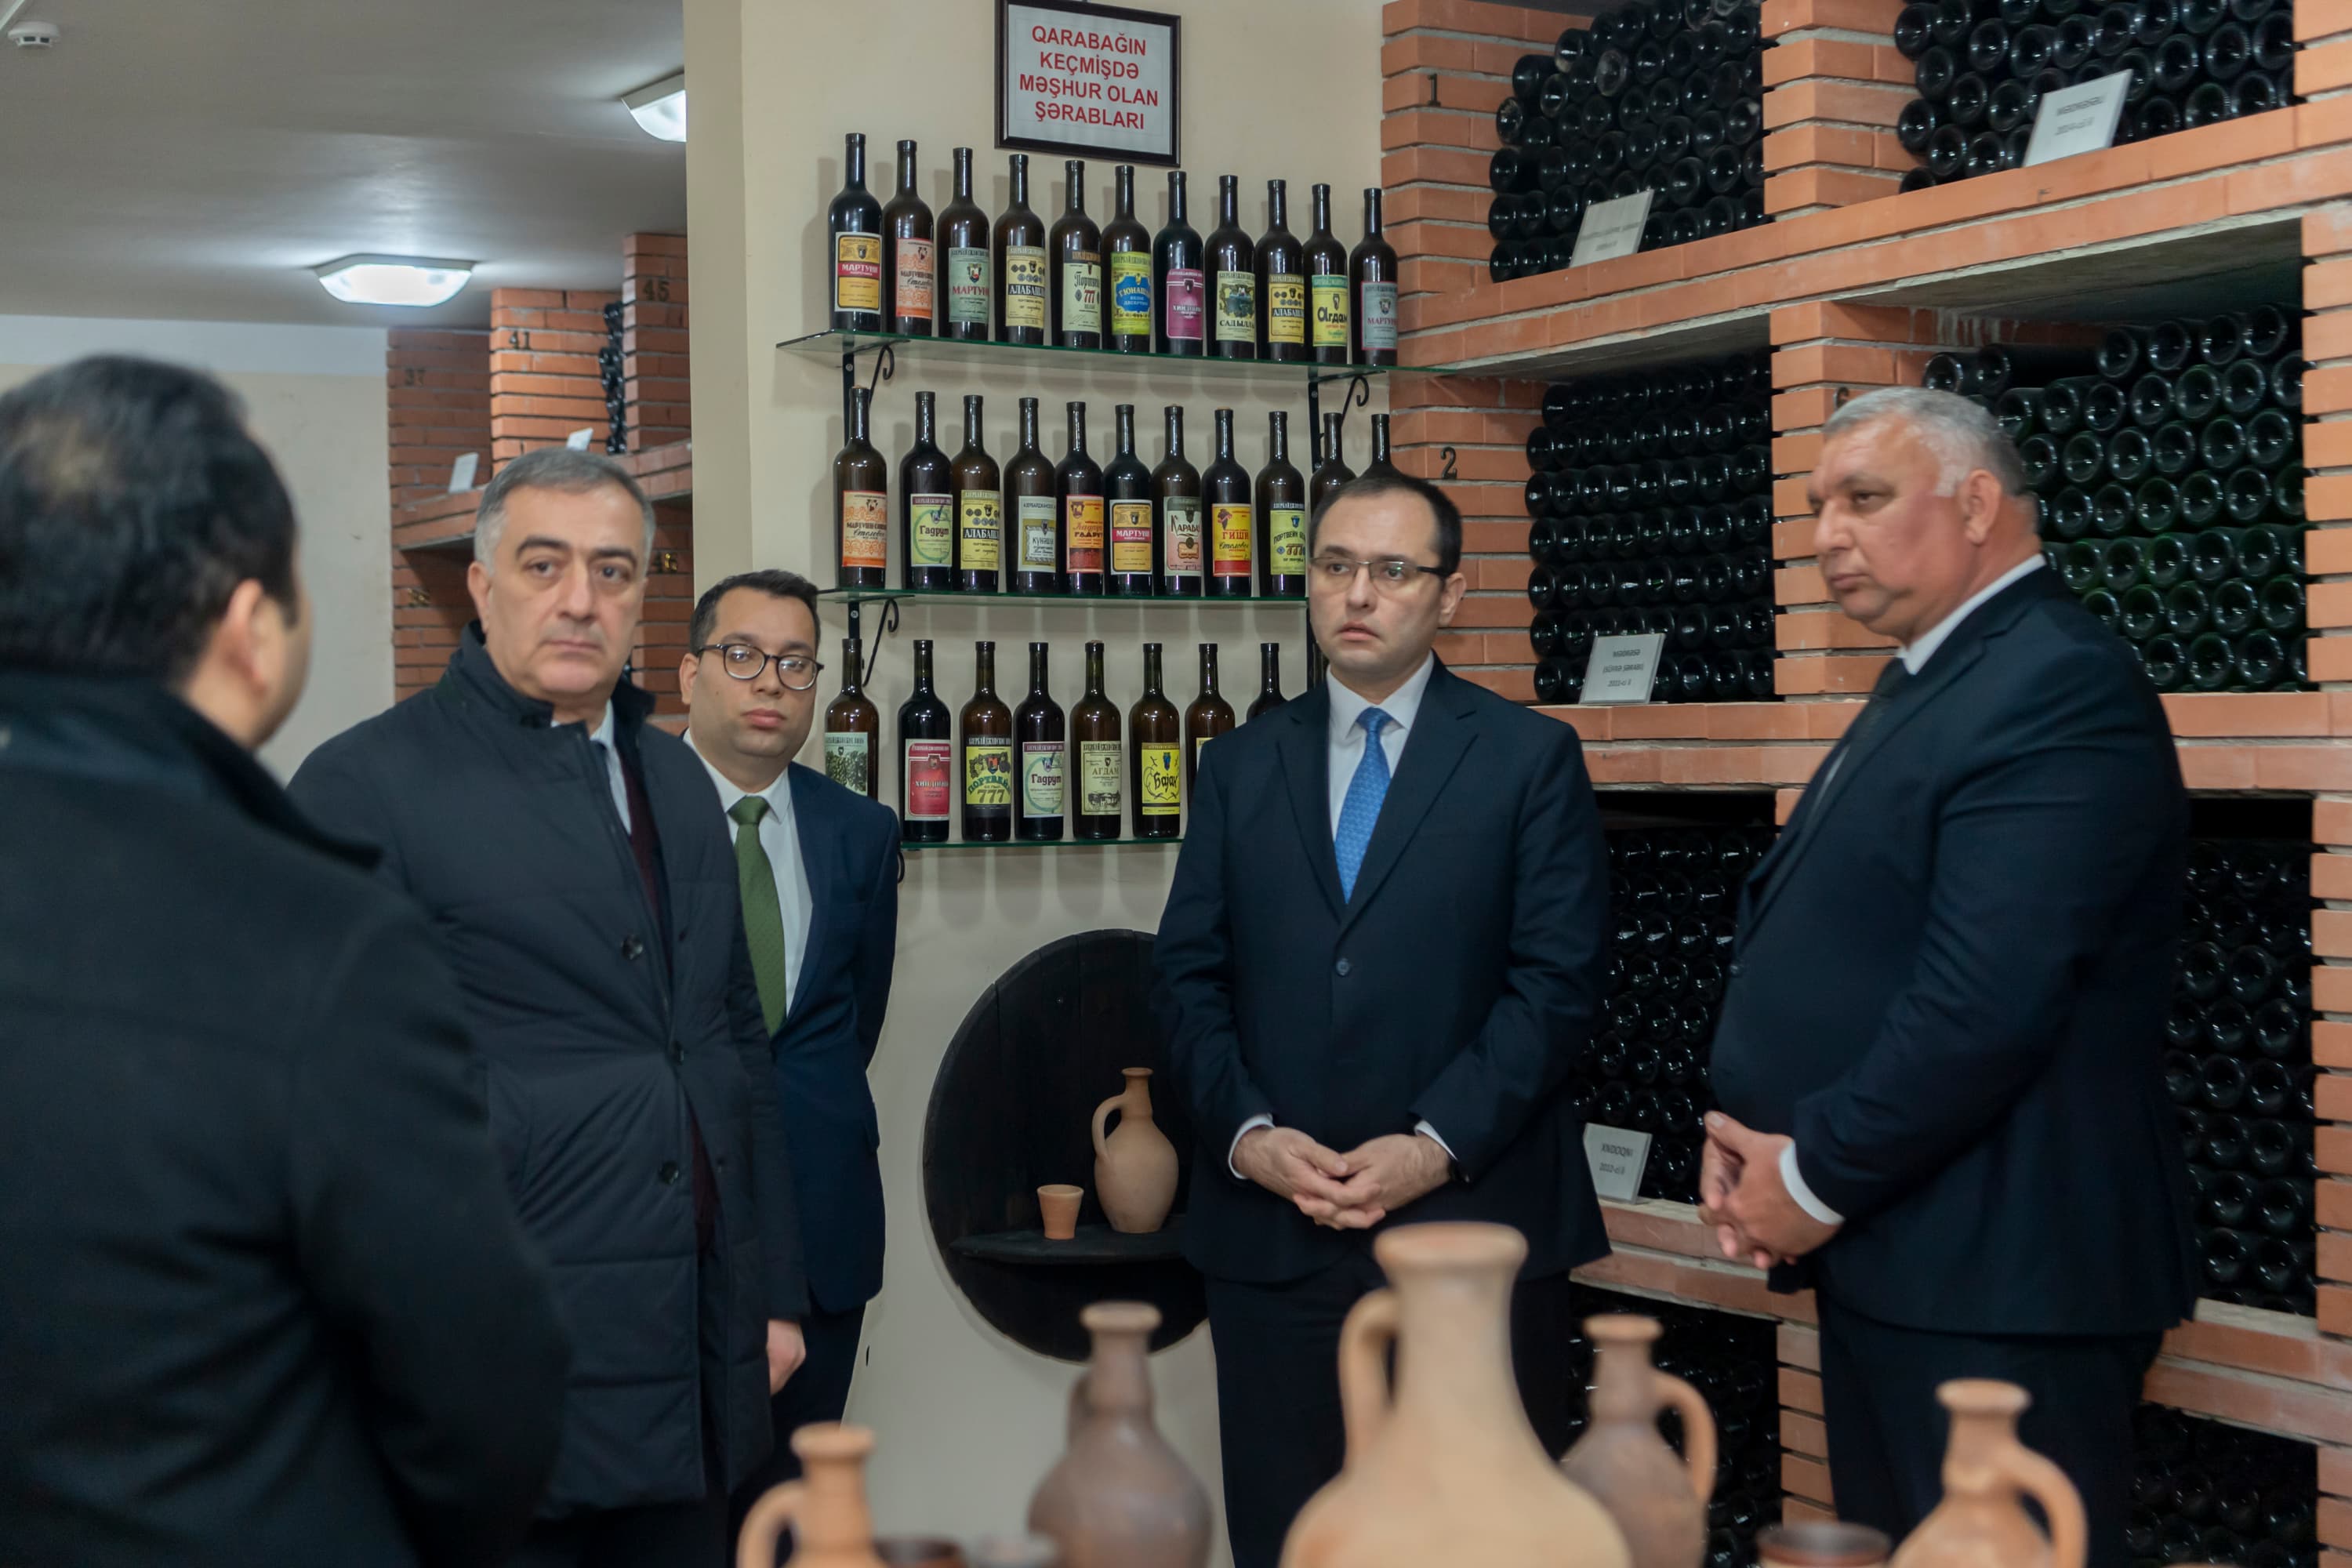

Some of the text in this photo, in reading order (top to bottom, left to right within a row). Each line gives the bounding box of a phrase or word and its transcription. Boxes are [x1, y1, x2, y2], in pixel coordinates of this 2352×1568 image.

[1032, 25, 1146, 56] QARABAĞIN
[1040, 51, 1139, 81] KEÇMİŞDƏ
[1019, 74, 1159, 107] MƏŞHUR OLAN
[1428, 73, 1441, 107] 1
[1035, 101, 1145, 130] ŞƏRABLARI
[643, 279, 670, 302] 45
[509, 330, 531, 350] 41
[1440, 446, 1457, 480] 2
[978, 789, 1005, 804] 777
